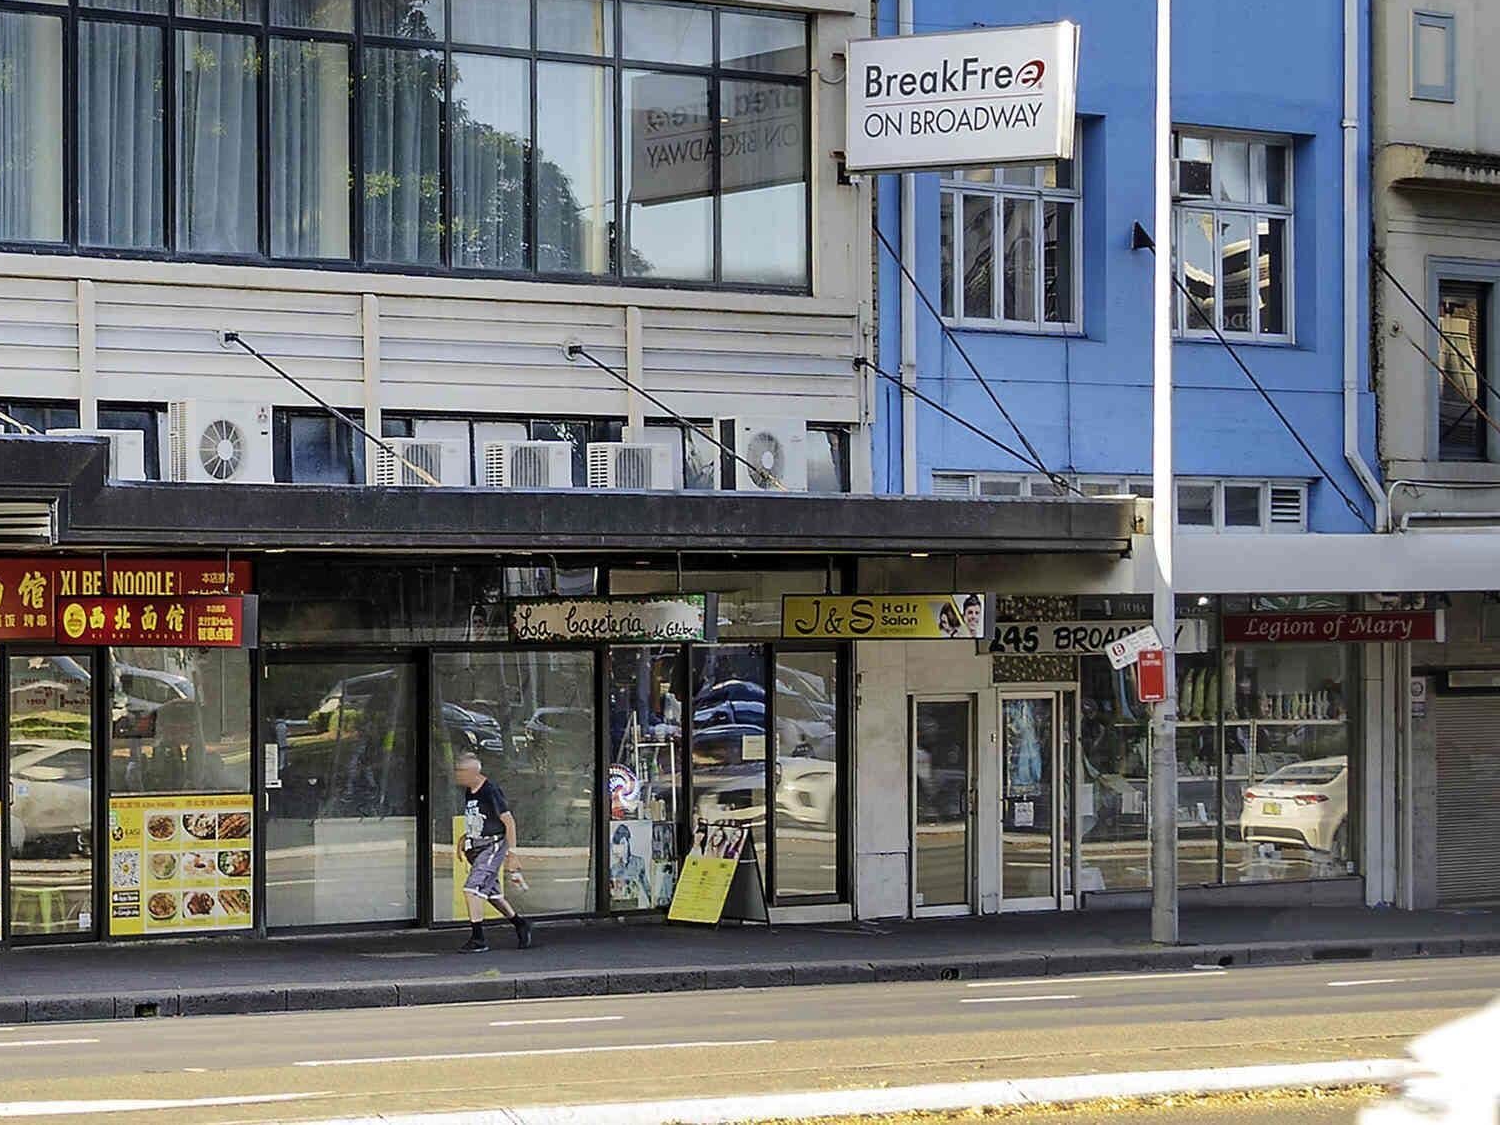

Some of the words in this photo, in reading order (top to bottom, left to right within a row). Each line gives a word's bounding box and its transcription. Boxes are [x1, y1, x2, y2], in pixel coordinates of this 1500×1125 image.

[864, 57, 1045, 99] BreakFree
[864, 113, 902, 138] ON
[910, 102, 1043, 135] BROADWAY
[60, 570, 77, 596] XI
[112, 570, 175, 596] NOODLE
[88, 603, 185, 632] 西北面馆
[519, 607, 550, 637] La
[565, 605, 644, 635] Cafeteria
[880, 615, 918, 626] Salon
[881, 602, 918, 613] Hair
[1244, 617, 1316, 641] Legion
[1323, 614, 1348, 638] of
[1349, 616, 1414, 639] Mary
